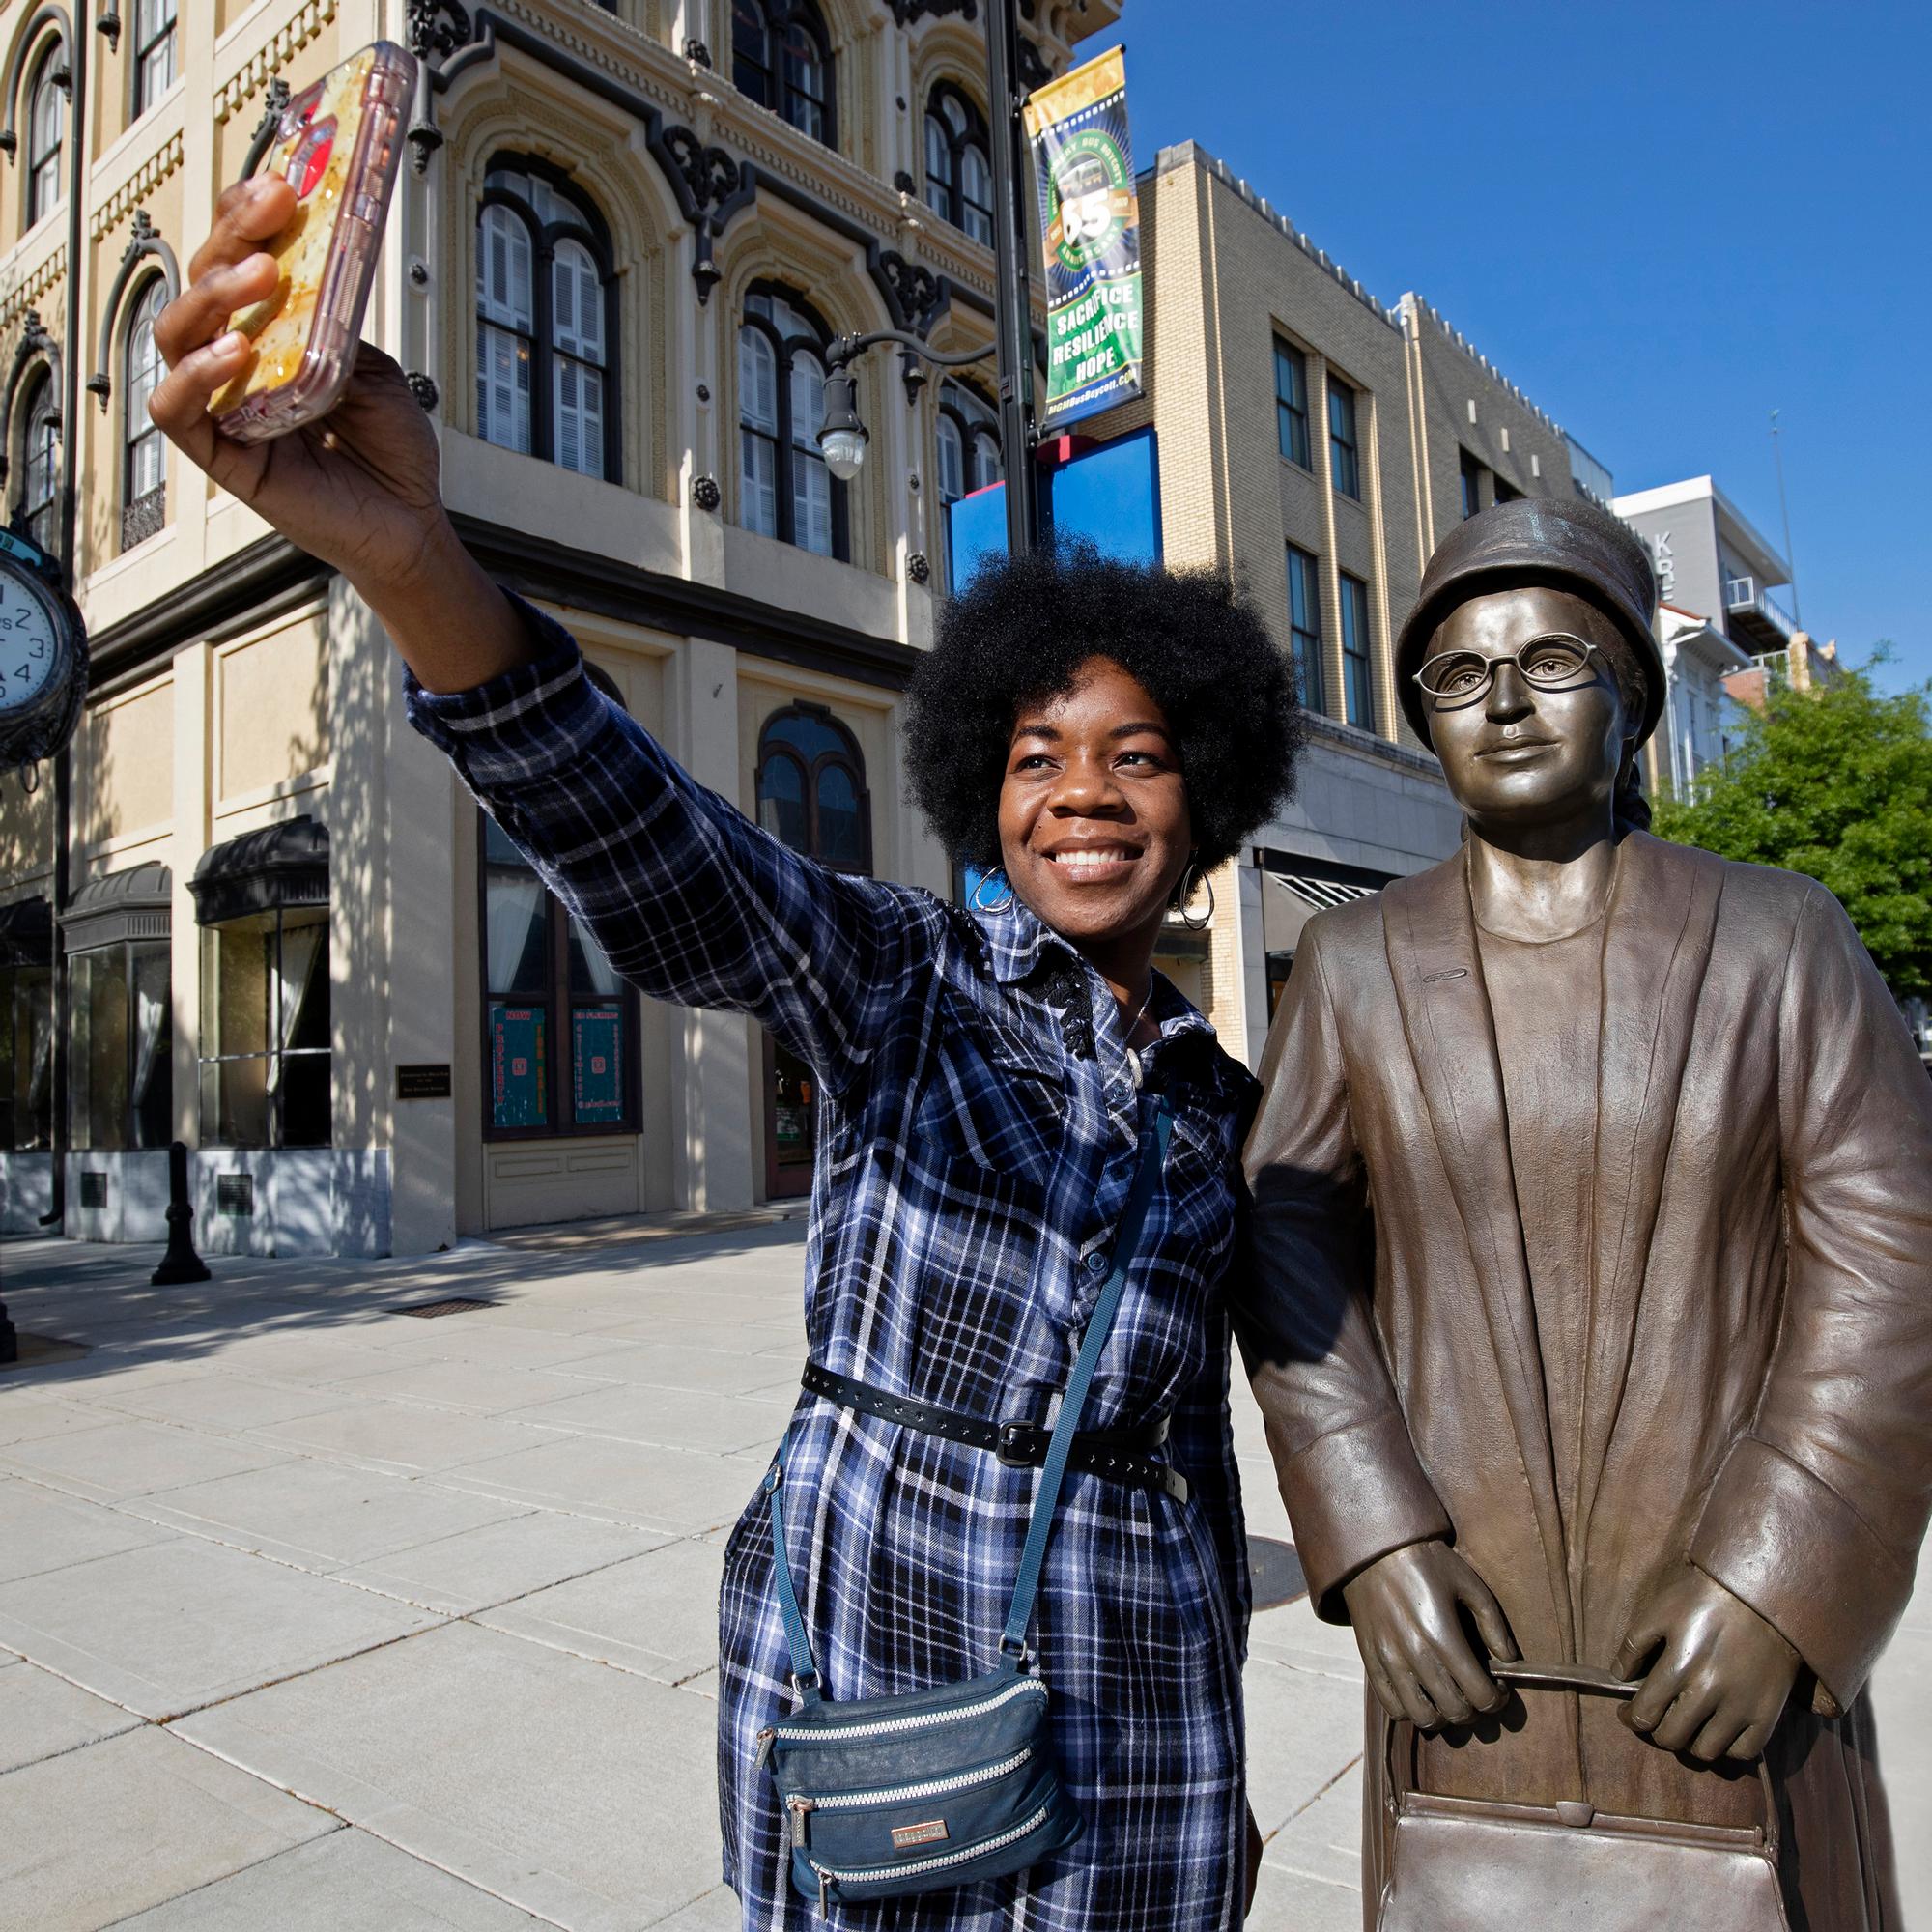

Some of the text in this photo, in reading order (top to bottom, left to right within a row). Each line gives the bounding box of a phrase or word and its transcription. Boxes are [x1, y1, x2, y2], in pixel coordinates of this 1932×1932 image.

[1081, 137, 1100, 148] BUS
[1100, 143, 1122, 185] BOYCOTT
[1062, 186, 1111, 246] 65
[1057, 283, 1133, 336] SACRIFICE
[1053, 310, 1138, 366] RESILIENCE
[1075, 346, 1115, 384] HOPE
[15, 608, 31, 630] 2
[29, 638, 44, 659] 3
[14, 663, 31, 683] 4
[505, 1010, 532, 1021] NOW
